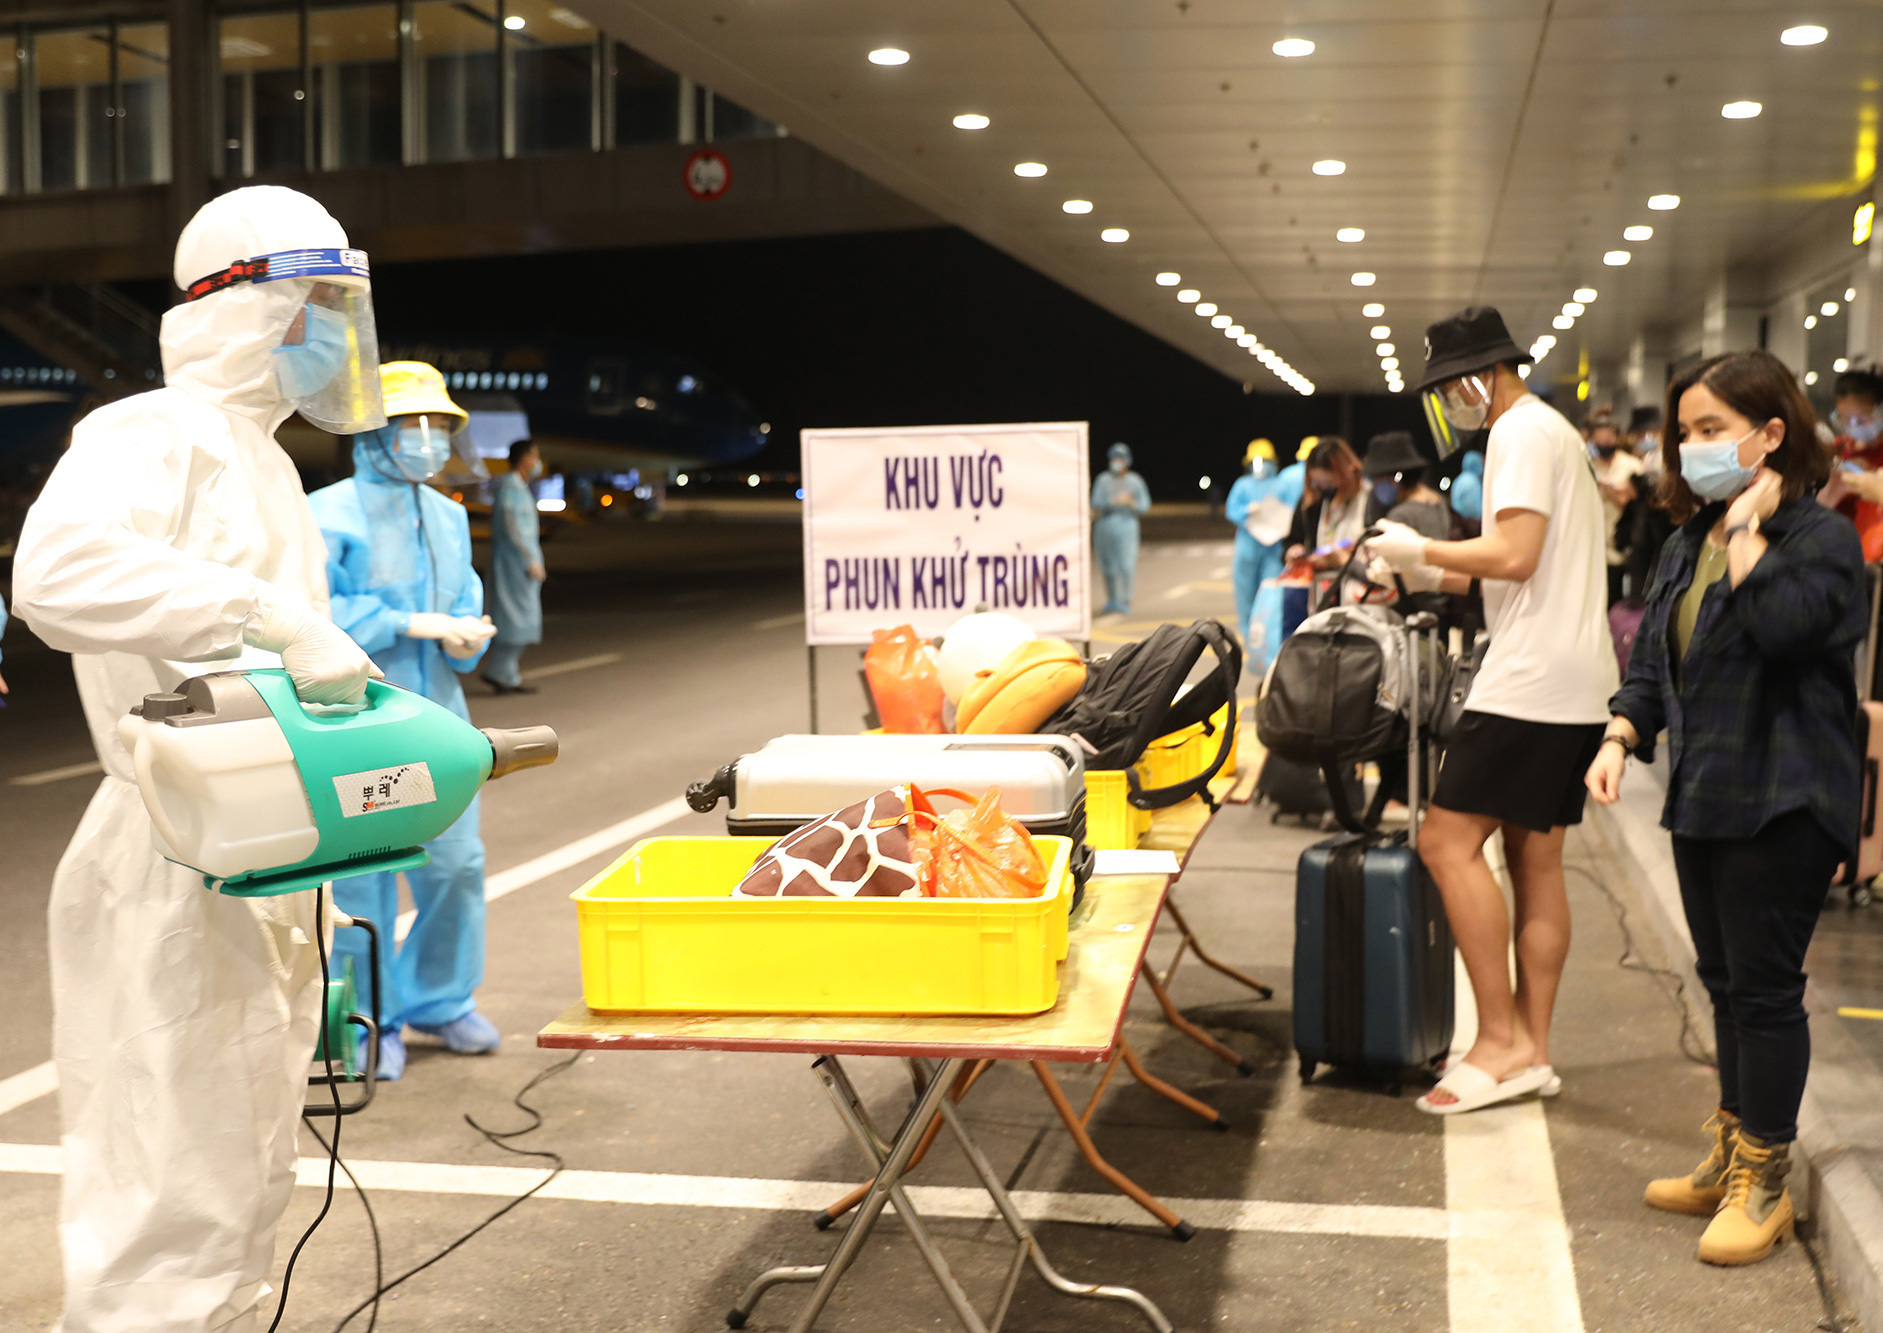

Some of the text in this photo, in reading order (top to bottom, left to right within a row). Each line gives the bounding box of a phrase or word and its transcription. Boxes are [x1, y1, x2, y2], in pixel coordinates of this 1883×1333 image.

[885, 449, 1004, 522] KHU VỰC
[824, 537, 1069, 611] PHUN KHỬ TRÙNG
